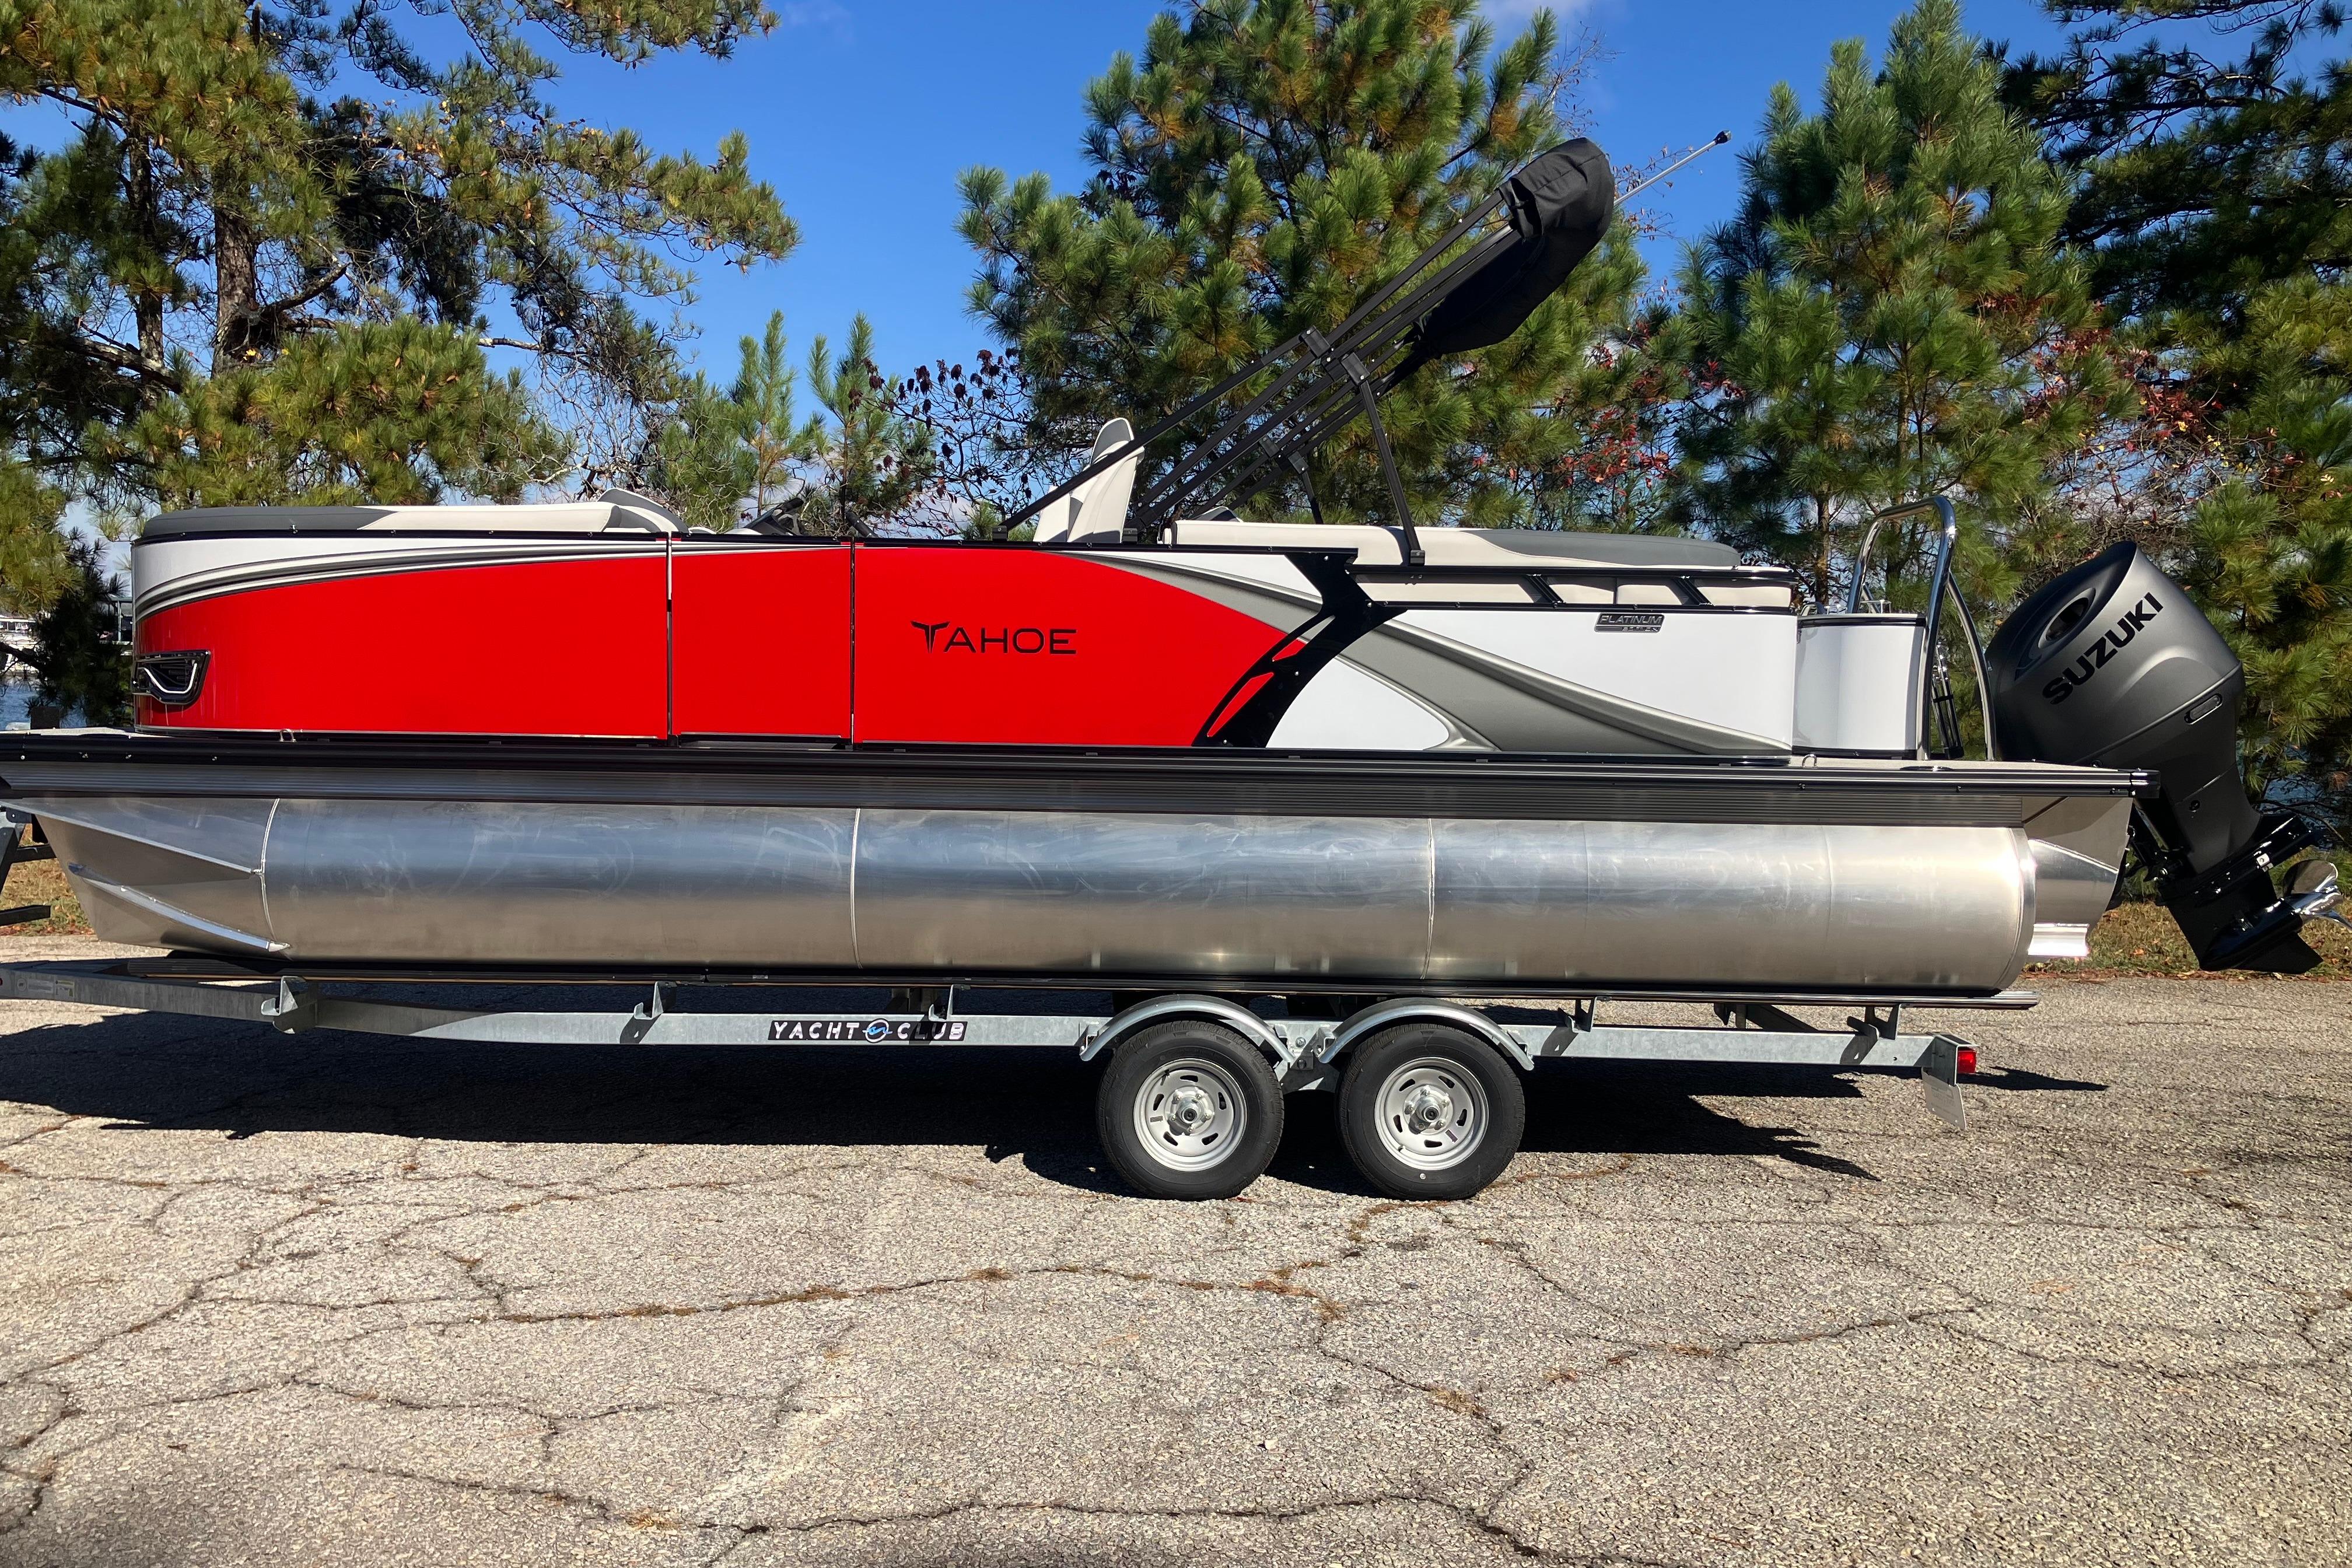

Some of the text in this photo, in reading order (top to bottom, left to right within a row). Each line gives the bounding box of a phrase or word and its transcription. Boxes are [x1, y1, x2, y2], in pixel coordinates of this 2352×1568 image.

[1600, 615, 1662, 624] PLATINUM
[910, 620, 1077, 654] TAHOE
[2042, 592, 2164, 705] SUZUKI
[774, 1021, 964, 1040] YACHT CLUB
